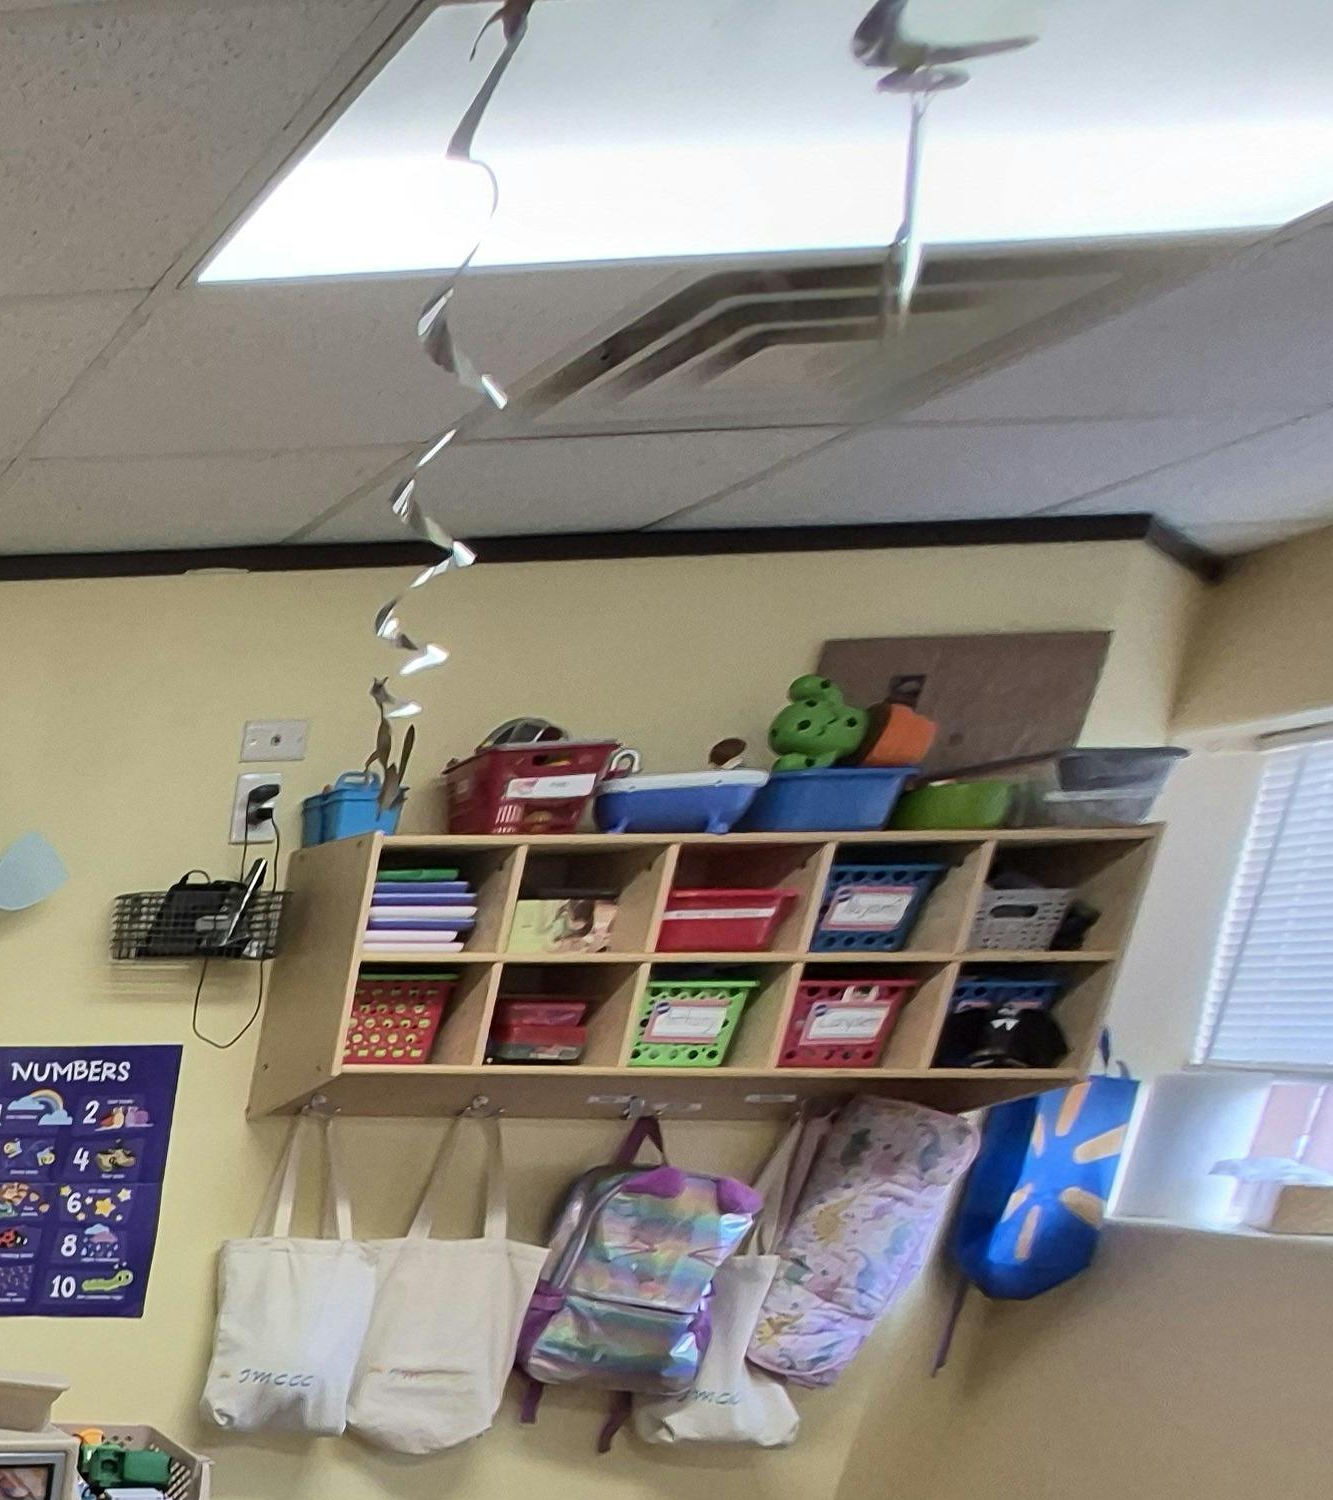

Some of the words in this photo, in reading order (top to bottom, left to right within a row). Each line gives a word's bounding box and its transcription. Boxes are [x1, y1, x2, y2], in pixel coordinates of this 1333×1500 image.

[10, 1060, 132, 1083] NUMBERS
[82, 1100, 101, 1125] 2
[72, 1147, 90, 1172] 4
[66, 1192, 83, 1214] 6
[60, 1234, 78, 1258] 8
[49, 1275, 77, 1299] 10
